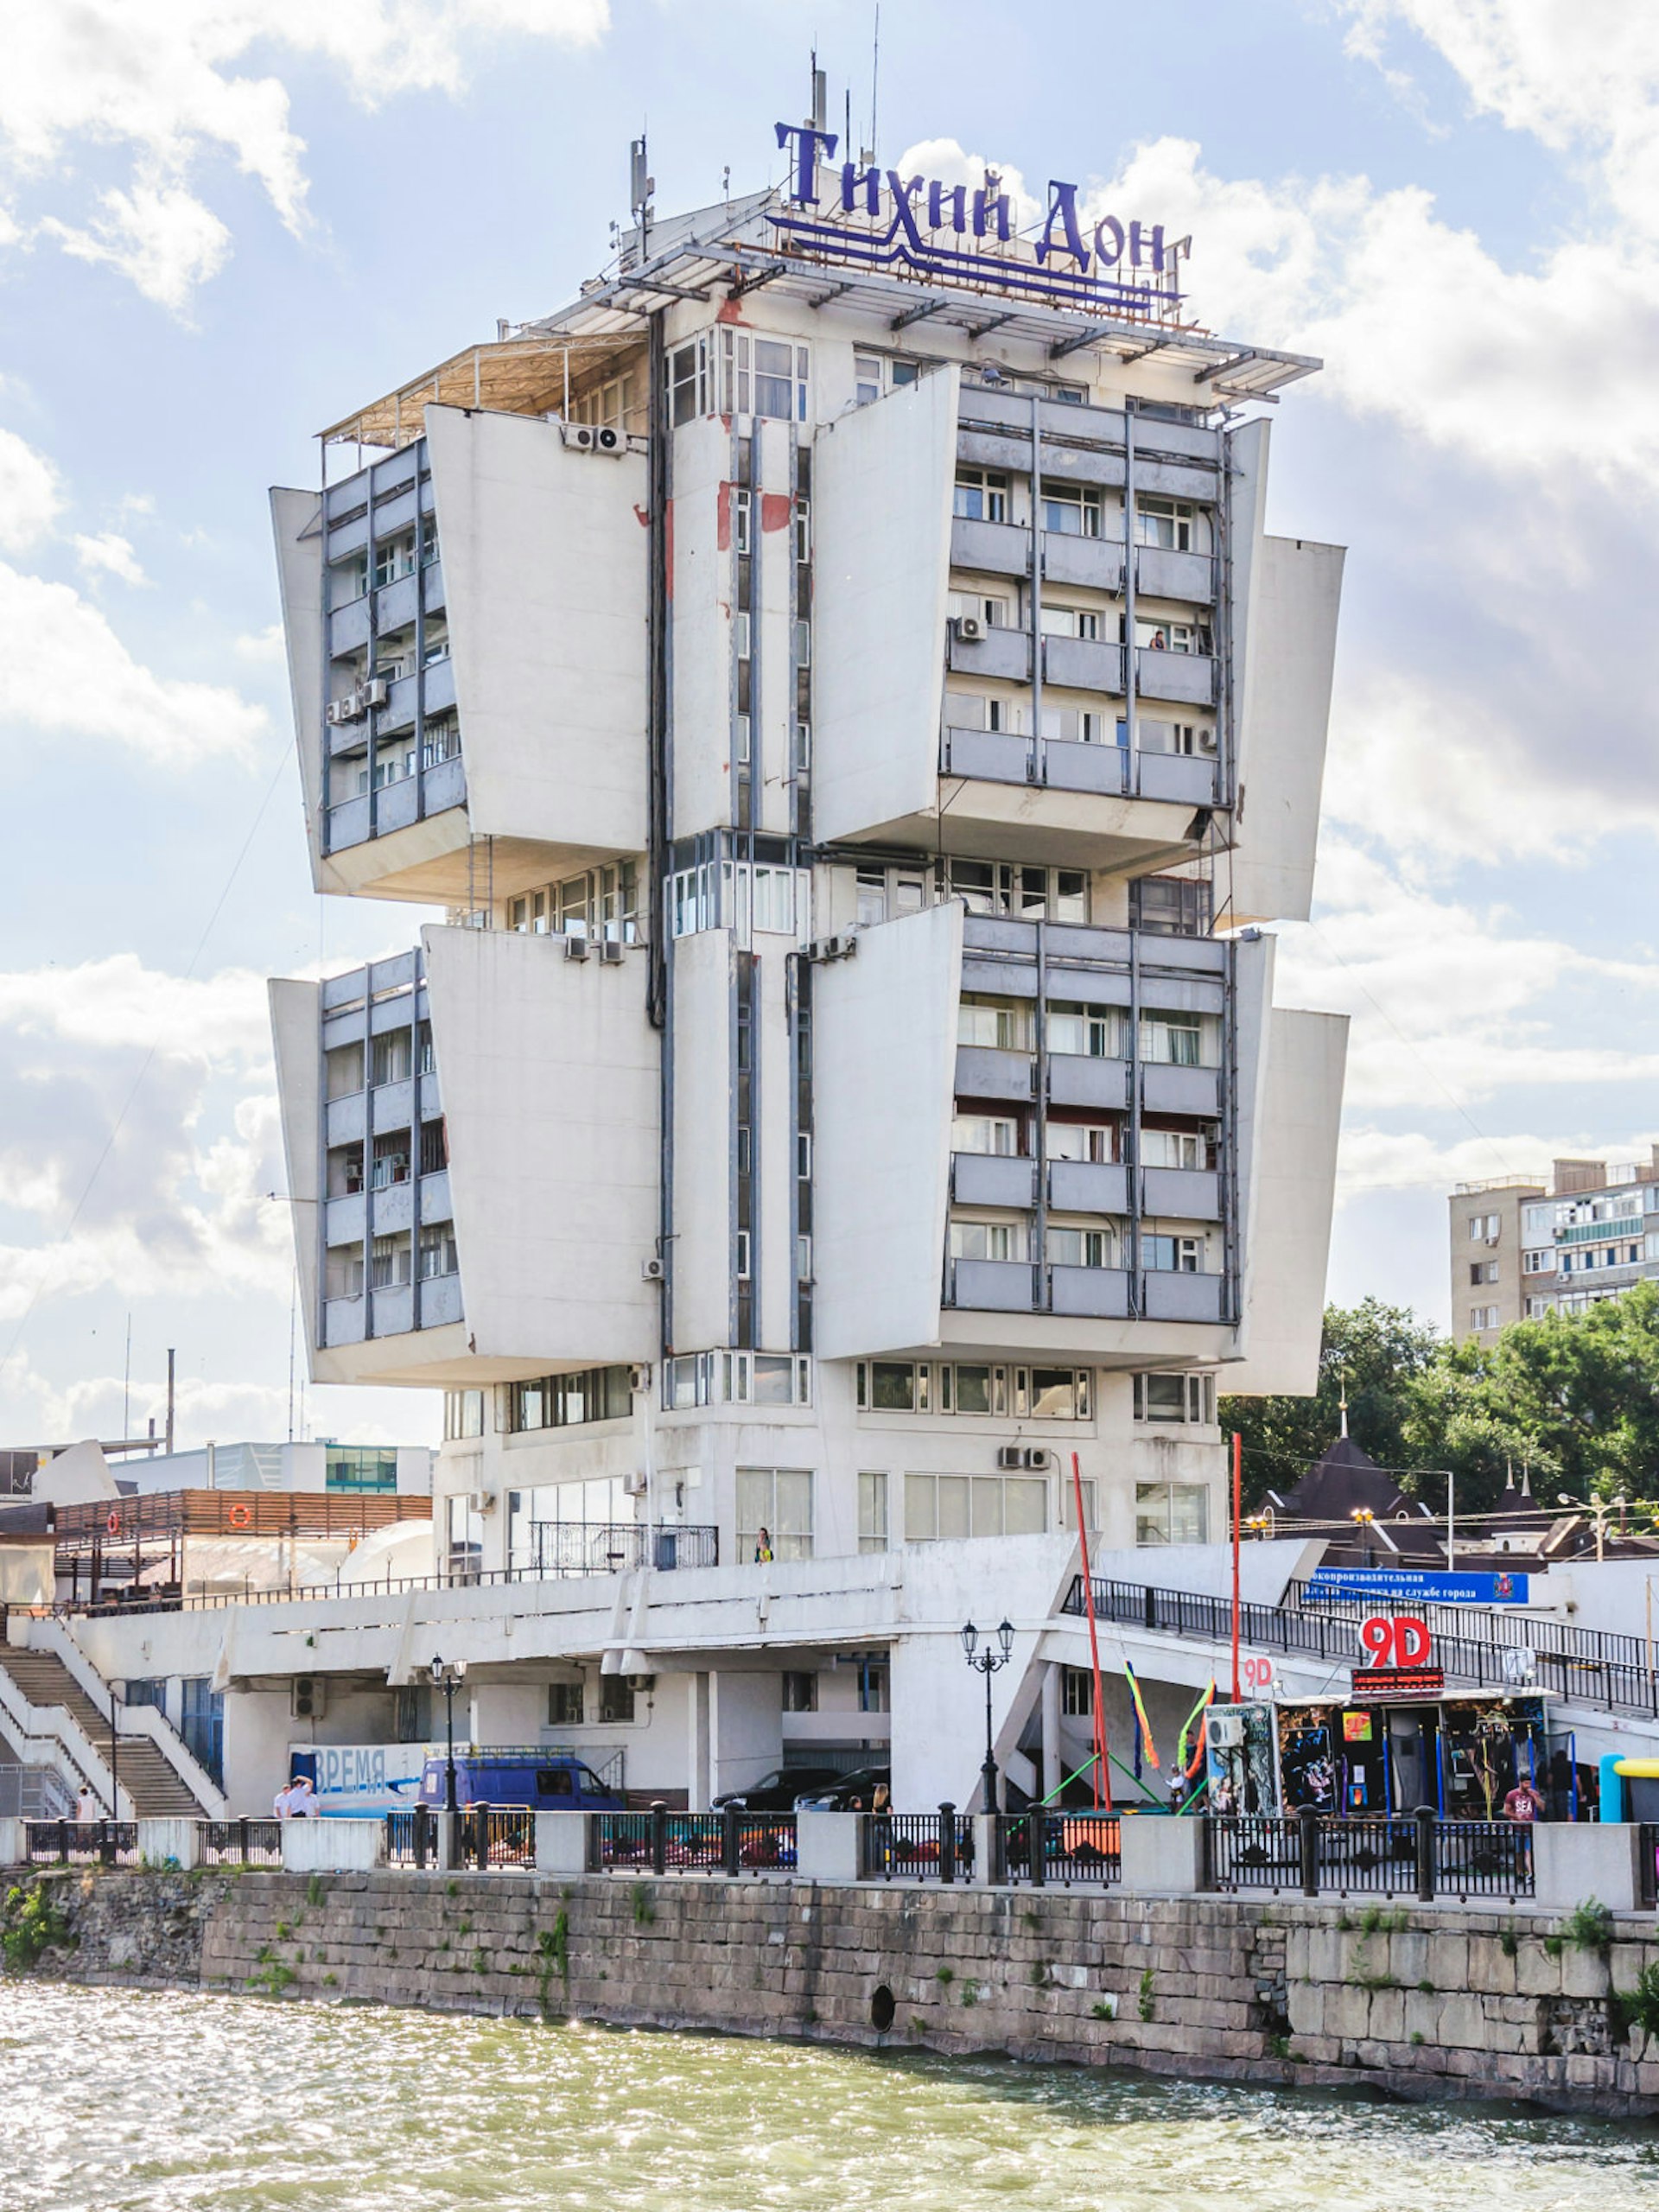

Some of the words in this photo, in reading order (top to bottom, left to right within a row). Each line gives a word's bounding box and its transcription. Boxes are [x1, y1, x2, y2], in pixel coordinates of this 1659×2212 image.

[1035, 179, 1164, 274] Дон
[1405, 1586, 1441, 1599] службе
[1442, 1589, 1477, 1600] города
[1361, 1617, 1432, 1668] 9D
[1244, 1658, 1272, 1687] 9D
[1515, 1800, 1533, 1813] SEA
